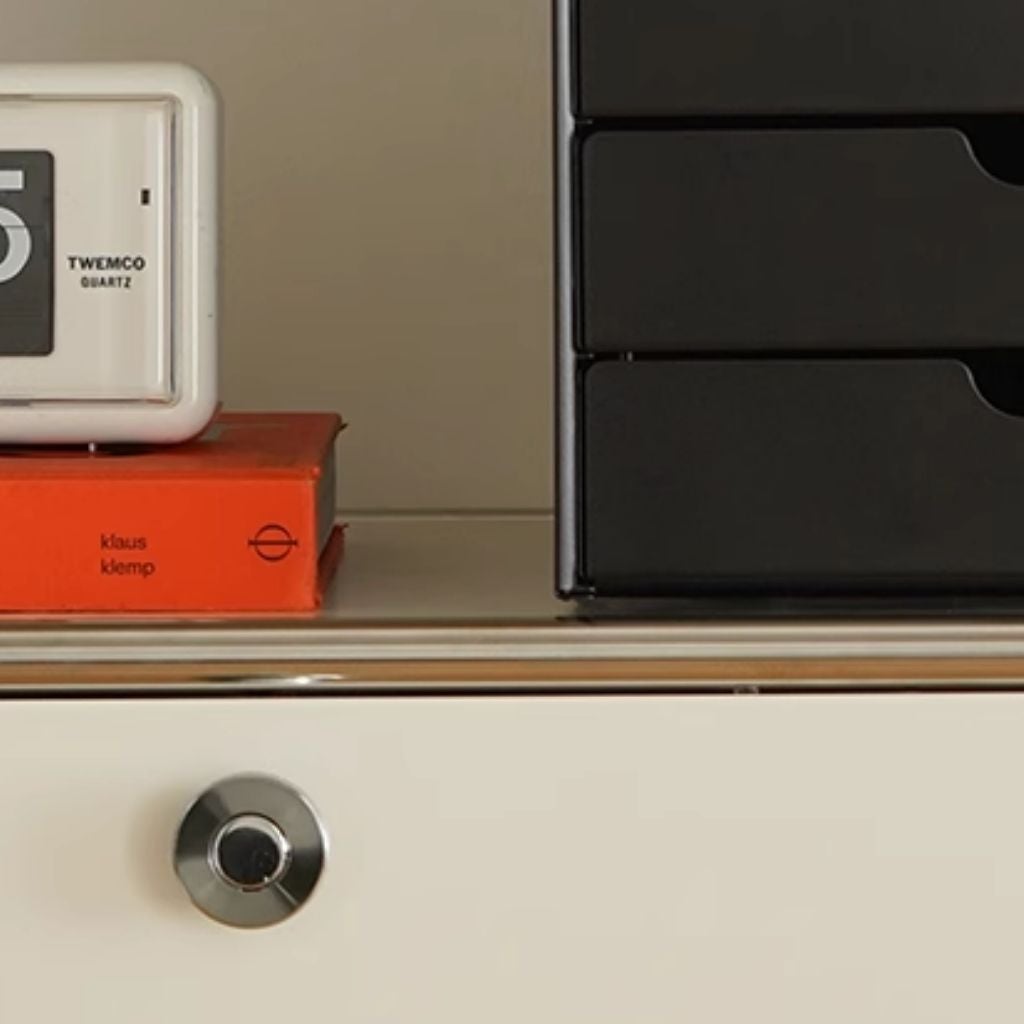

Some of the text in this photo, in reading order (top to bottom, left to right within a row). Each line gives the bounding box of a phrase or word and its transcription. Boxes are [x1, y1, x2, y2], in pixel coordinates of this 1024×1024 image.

[67, 256, 146, 271] TWEMCO
[80, 276, 132, 289] QUARTZ
[100, 533, 147, 551] klaus
[100, 558, 156, 578] klemp
